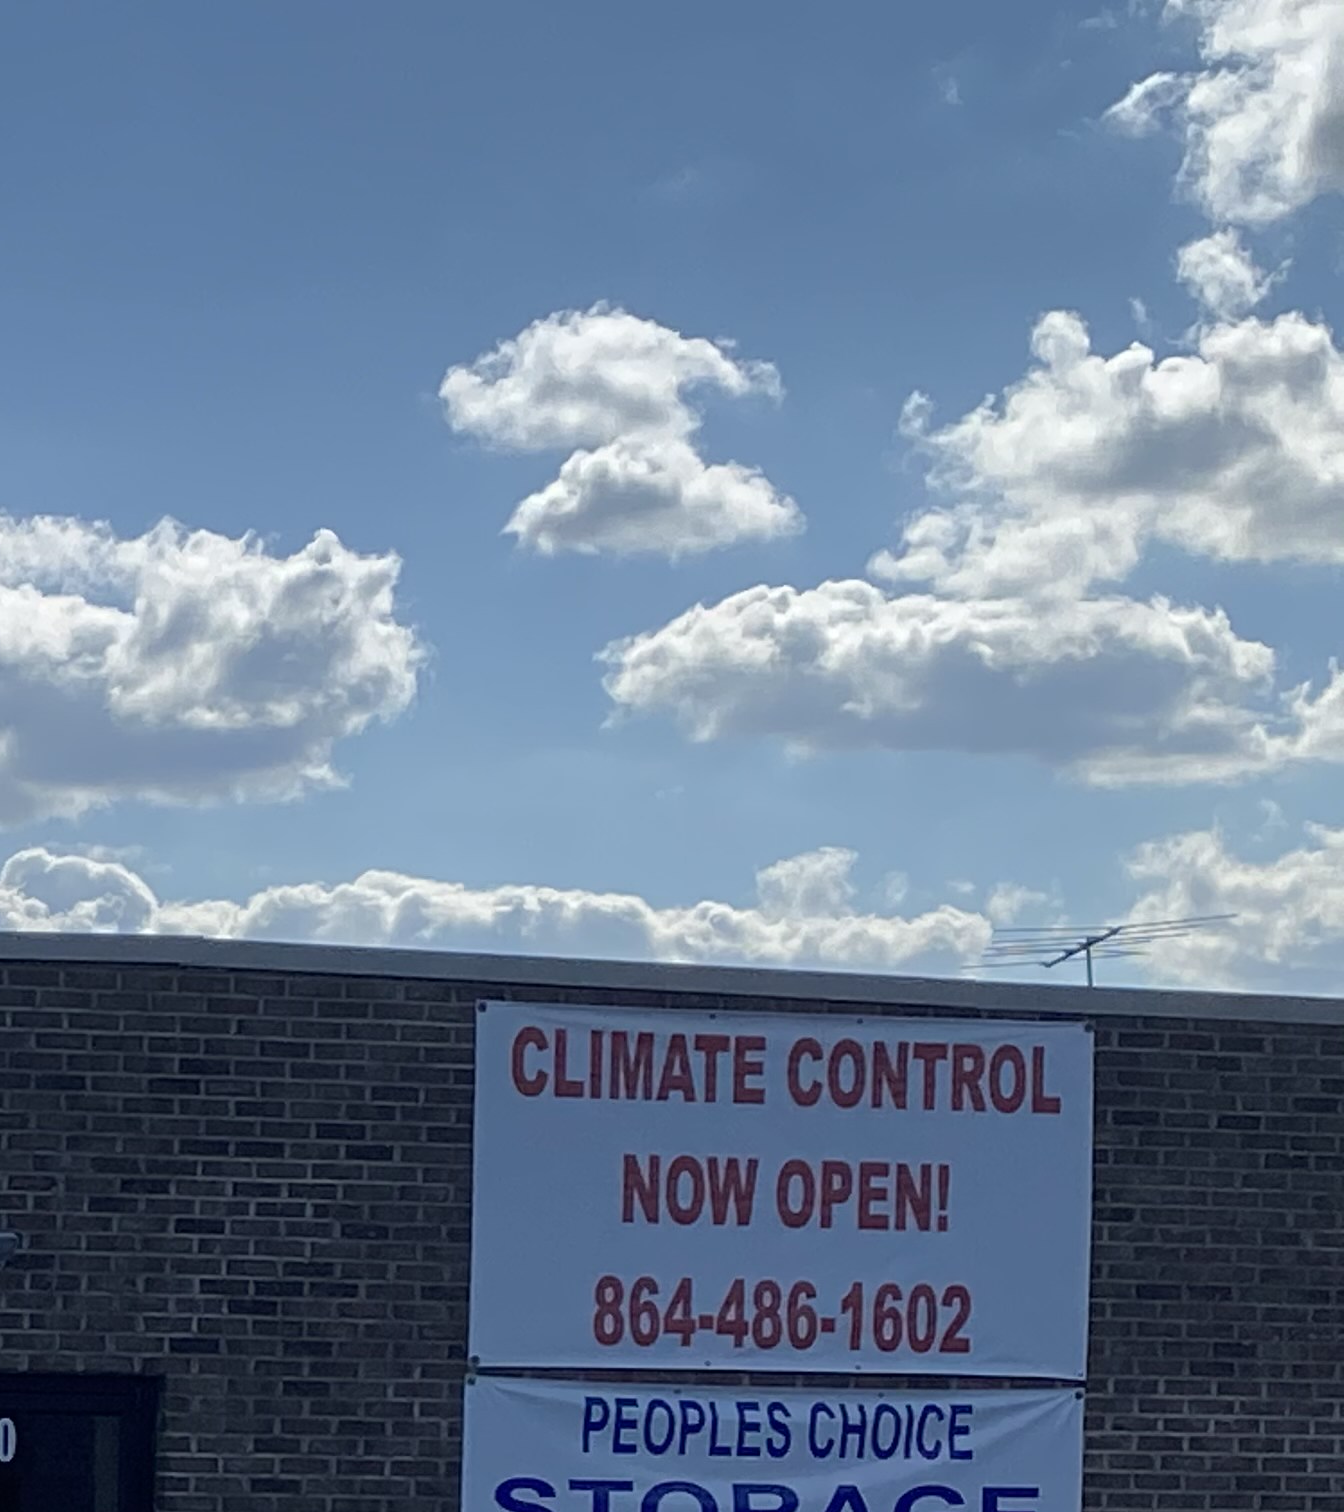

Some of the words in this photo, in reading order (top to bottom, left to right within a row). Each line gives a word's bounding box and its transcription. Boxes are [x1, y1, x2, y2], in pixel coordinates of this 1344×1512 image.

[512, 1026, 766, 1104] CLIMATE
[787, 1038, 1061, 1114] CONTROL
[622, 1154, 759, 1226] NOW
[776, 1159, 949, 1232] OPEN!
[593, 1276, 971, 1353] 864-486-1602
[582, 1396, 792, 1458] PEOPLES
[808, 1401, 973, 1460] CHOICE
